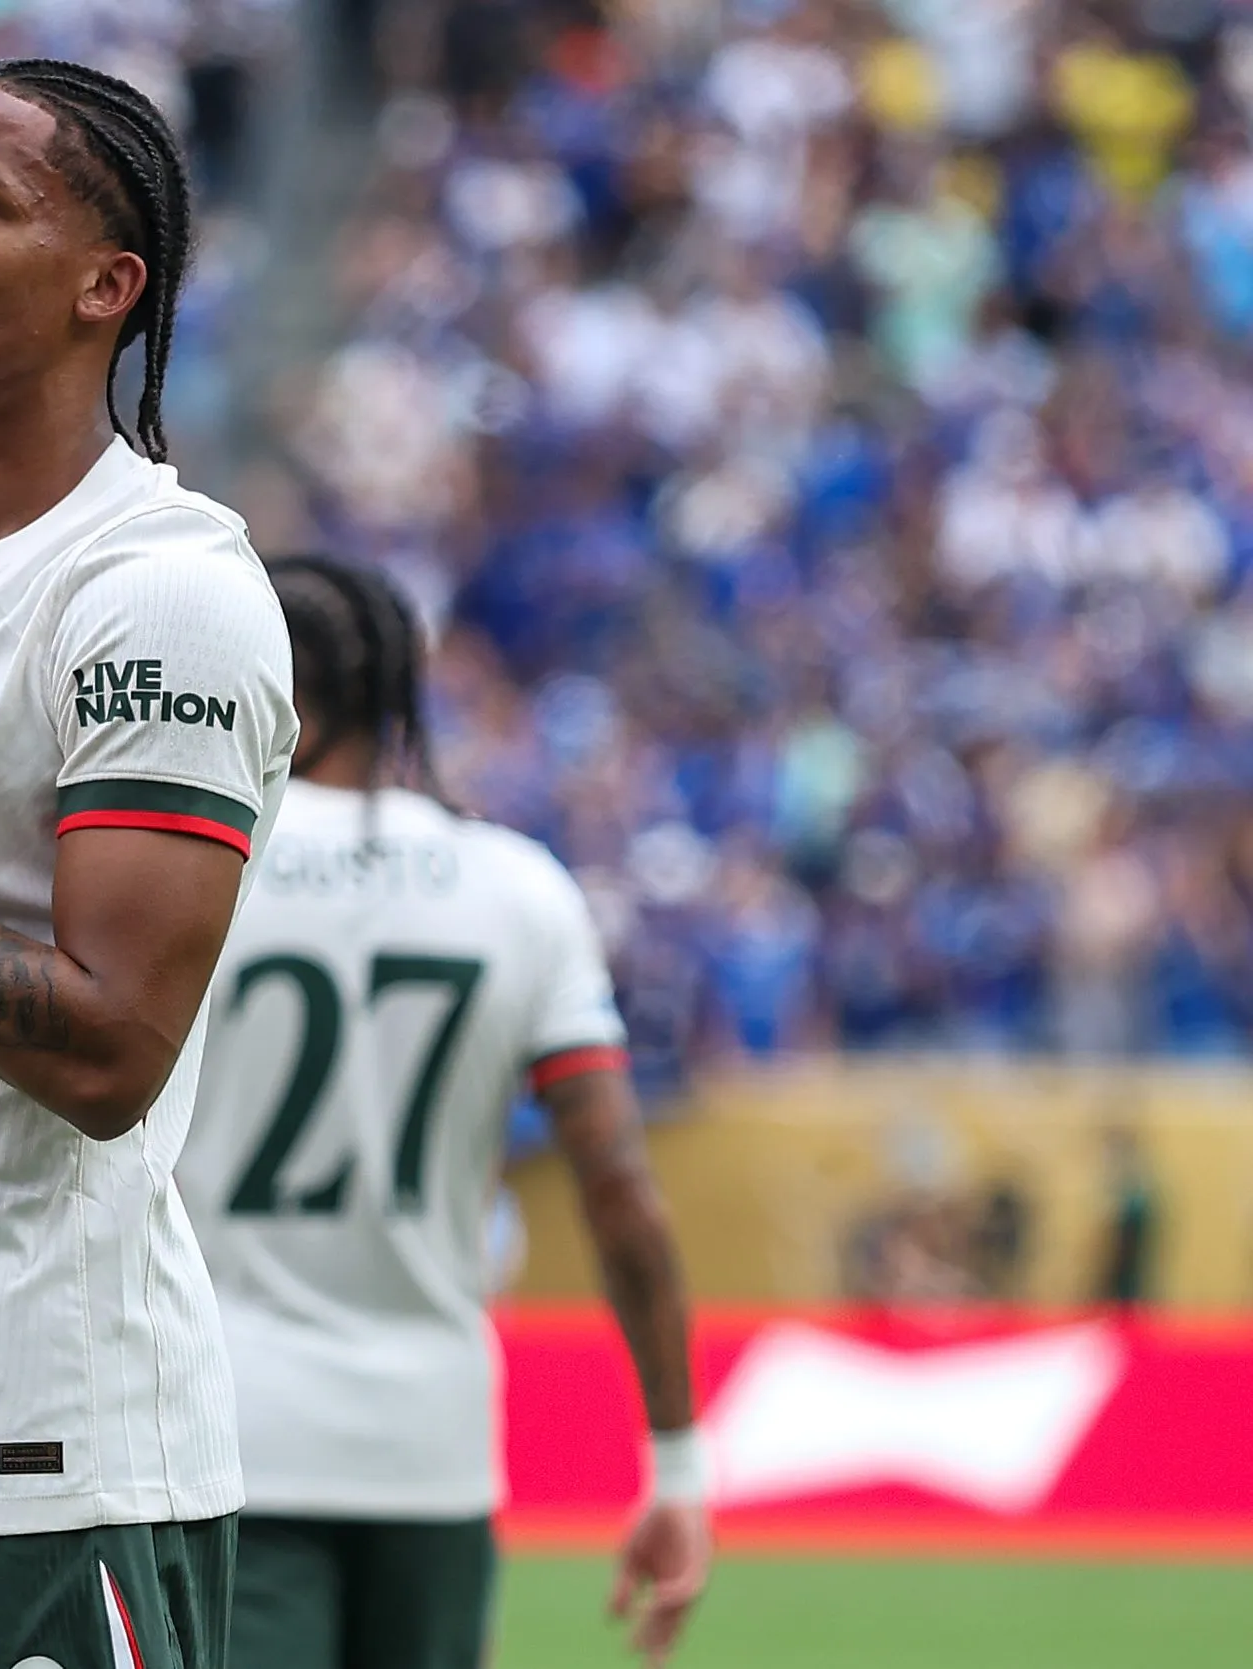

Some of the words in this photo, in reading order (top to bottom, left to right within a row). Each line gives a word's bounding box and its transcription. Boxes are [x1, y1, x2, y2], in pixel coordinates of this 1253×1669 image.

[72, 660, 162, 695] LIVE
[75, 691, 237, 731] NATION
[226, 953, 484, 1216] 27
